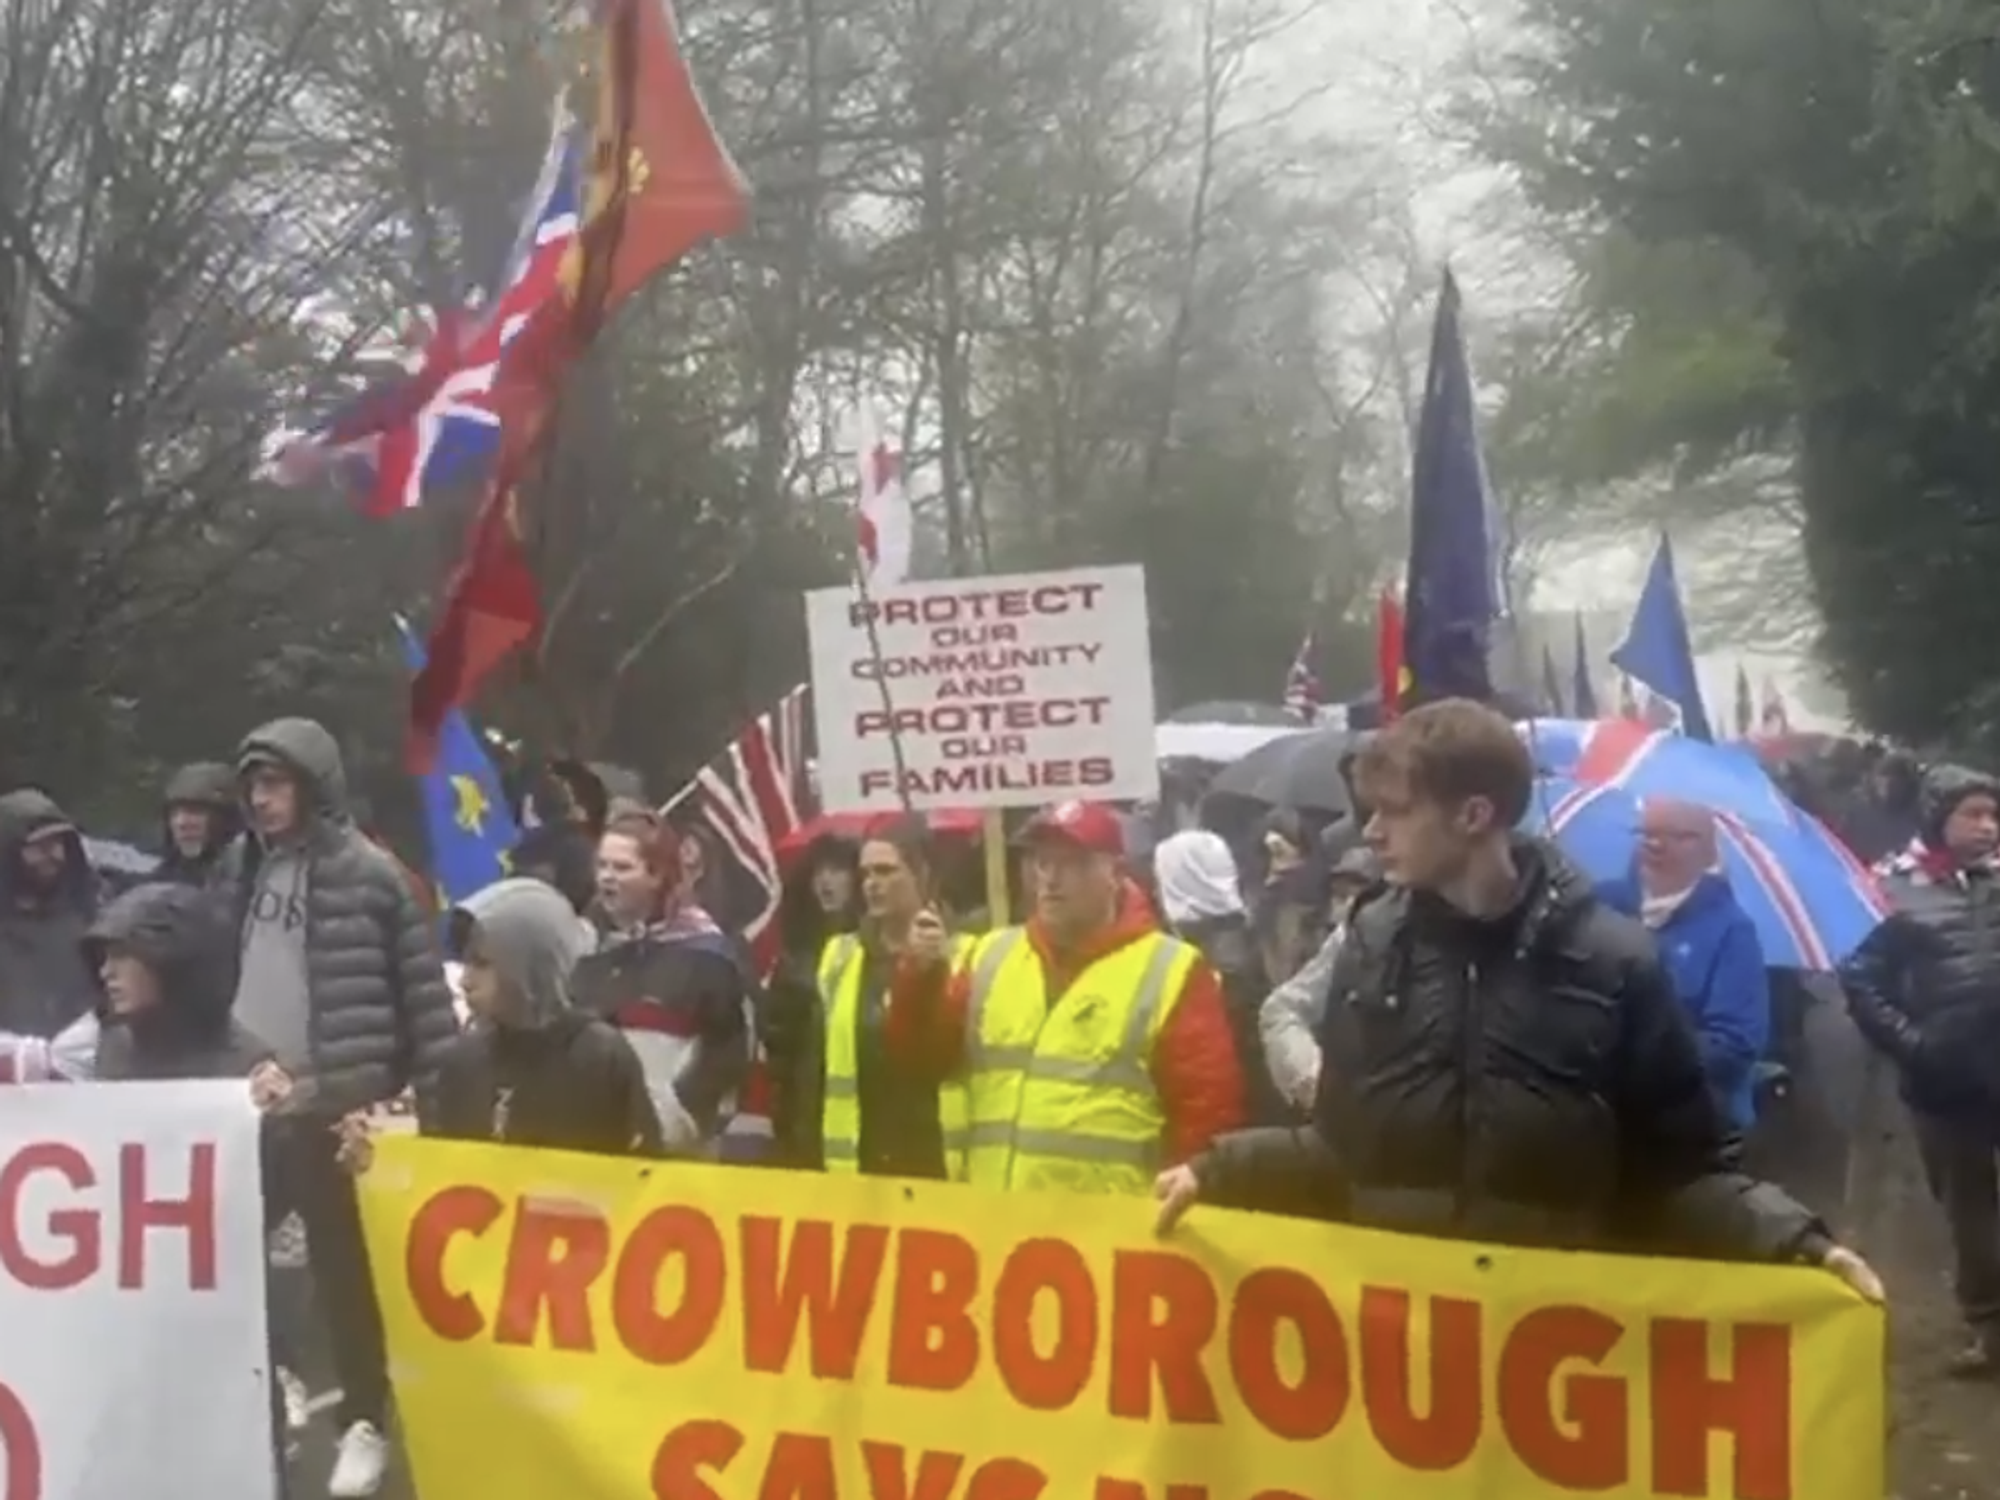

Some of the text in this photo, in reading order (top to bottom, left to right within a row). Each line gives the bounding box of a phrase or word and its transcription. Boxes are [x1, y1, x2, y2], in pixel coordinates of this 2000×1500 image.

[849, 584, 1103, 627] PROTECT
[931, 624, 1018, 648] OUR
[852, 643, 1102, 680] COMMUNITY
[936, 675, 1025, 699] AND
[855, 697, 1111, 738] PROTECT
[940, 735, 1027, 759] OUR
[859, 758, 1115, 797] FAMILIES
[406, 1184, 1791, 1498] CROWBOROUGH
